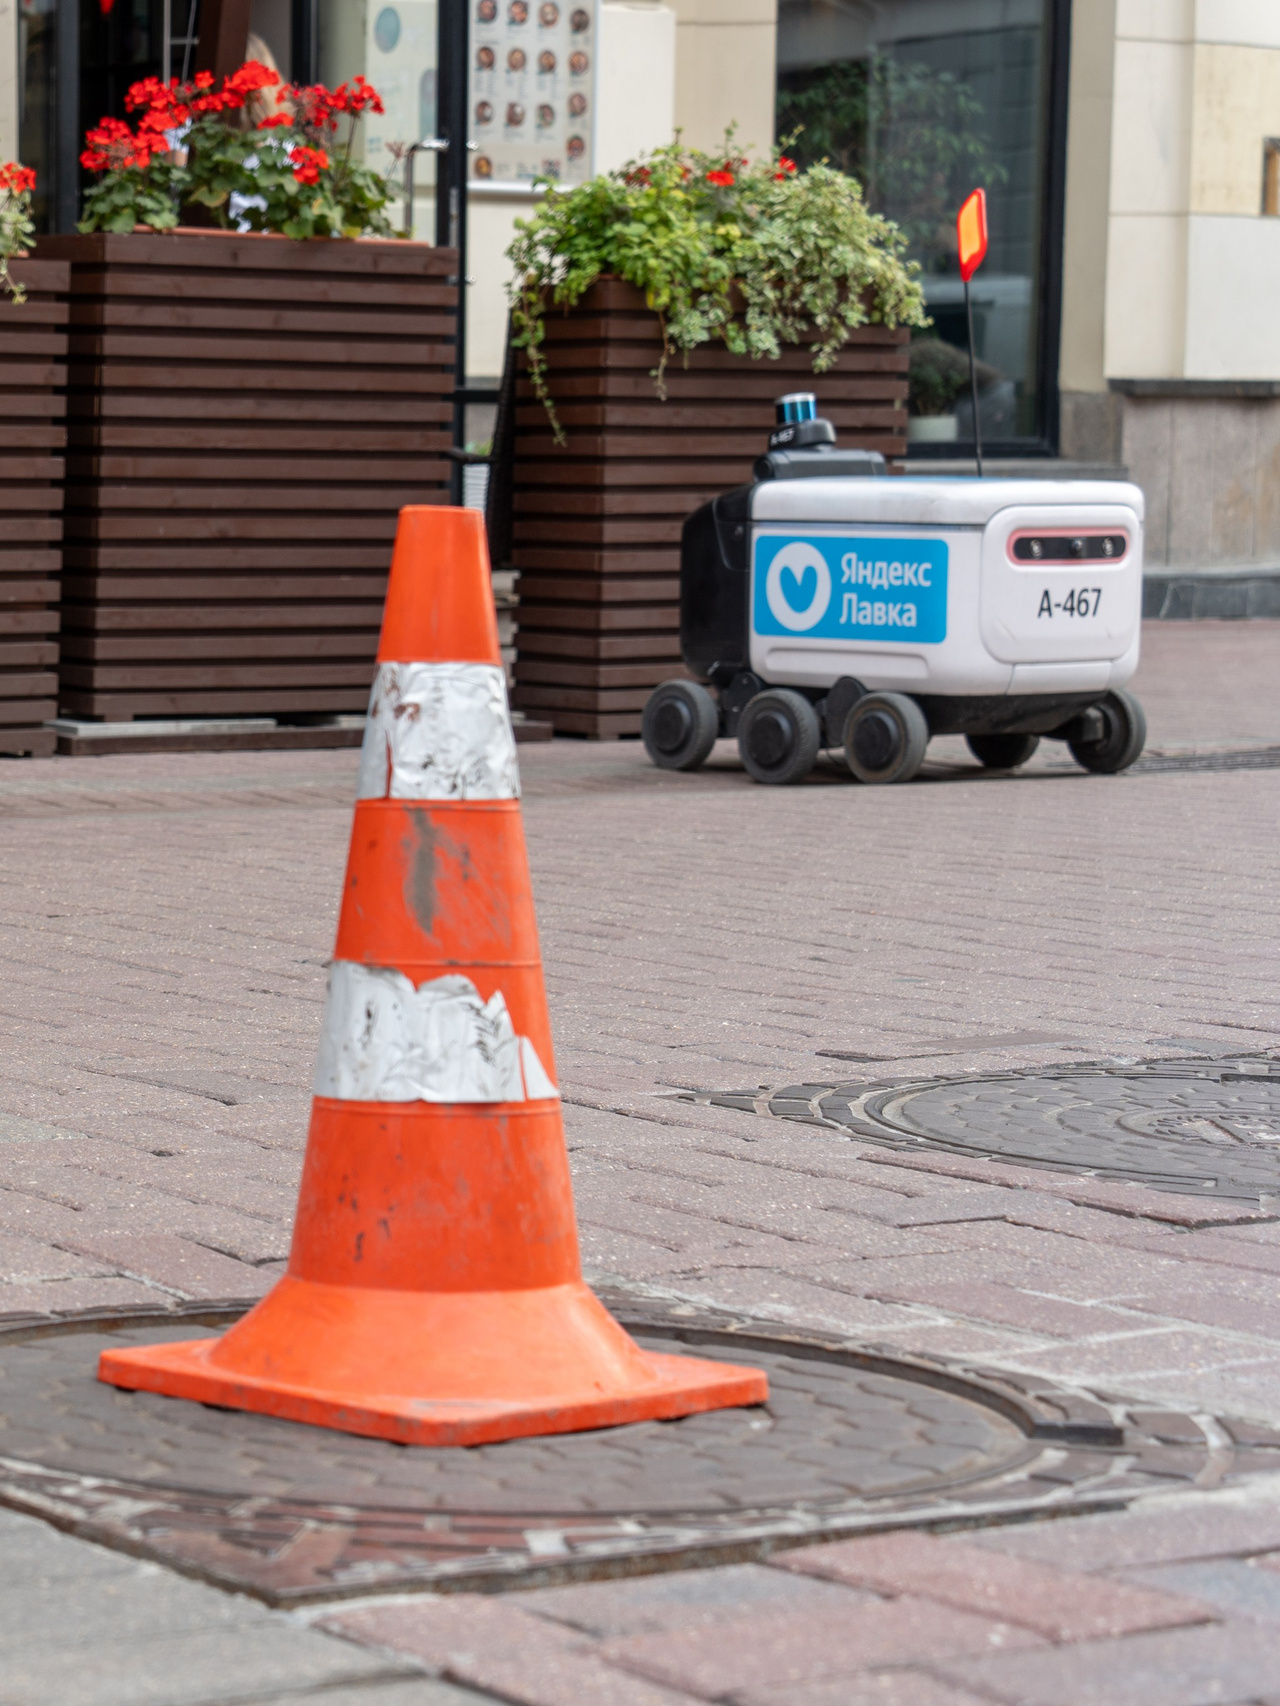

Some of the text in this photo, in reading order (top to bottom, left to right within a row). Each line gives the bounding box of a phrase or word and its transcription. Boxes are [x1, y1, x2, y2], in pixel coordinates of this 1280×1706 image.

[840, 552, 932, 590] Яндекс
[839, 593, 917, 627] Лавка
[1037, 588, 1102, 618] A-467
